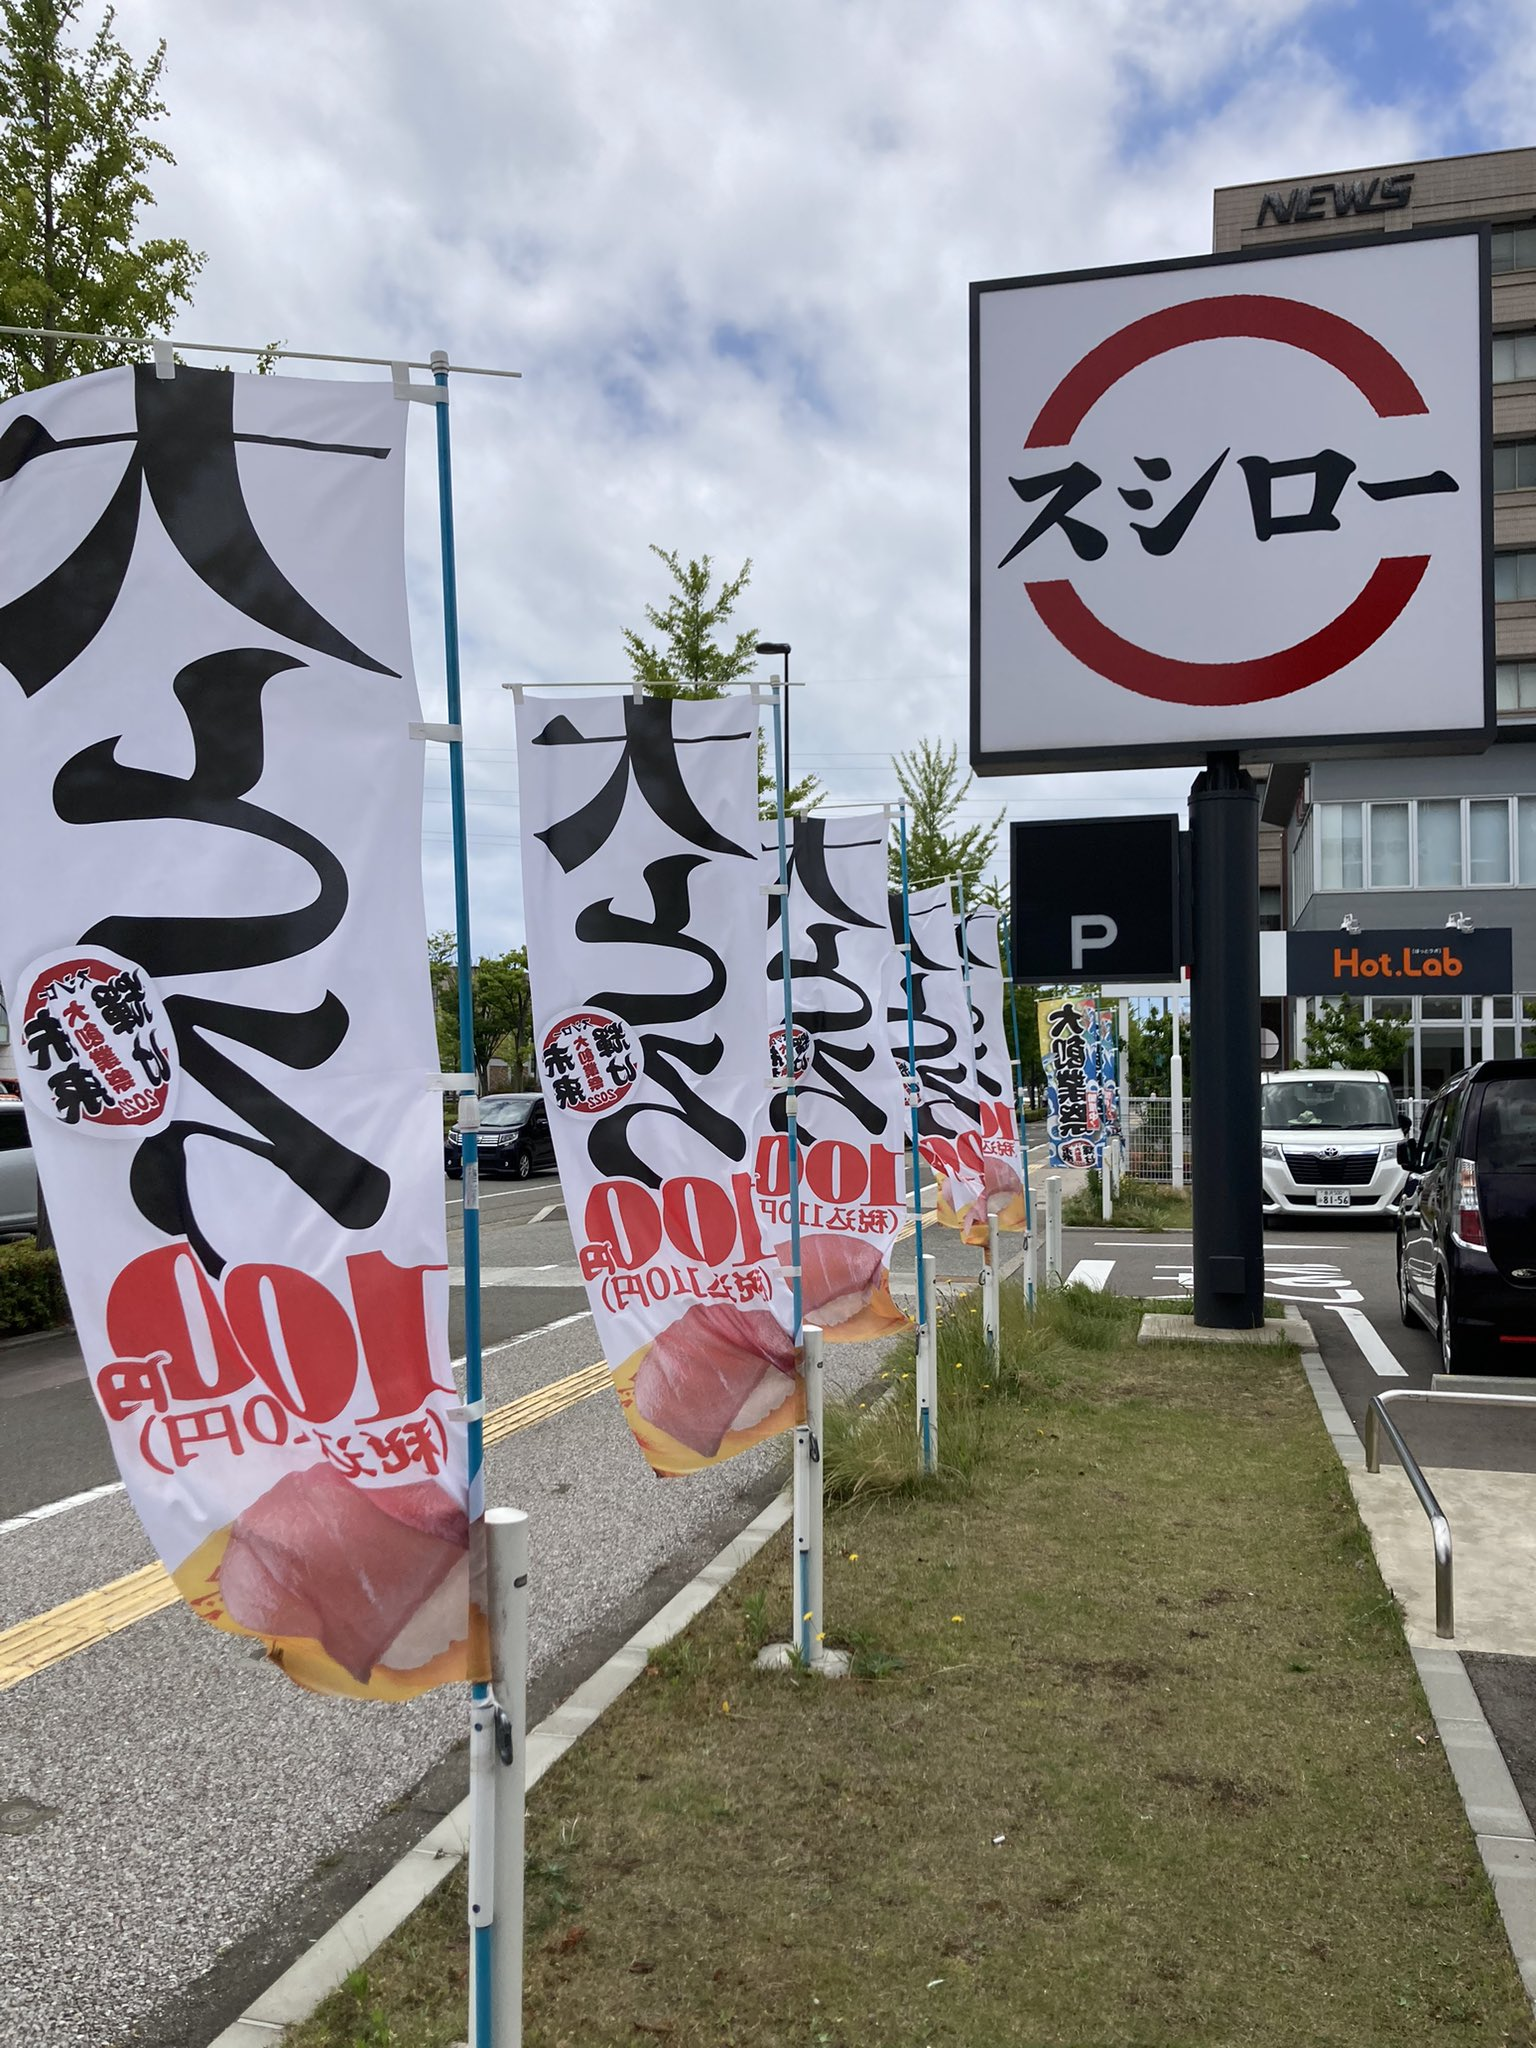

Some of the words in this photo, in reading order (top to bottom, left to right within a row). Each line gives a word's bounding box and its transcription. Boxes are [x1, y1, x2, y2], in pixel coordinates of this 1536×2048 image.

[1256, 173, 1415, 227] NEWS
[998, 447, 1460, 570] スシロー
[1070, 914, 1118, 970] P
[1334, 947, 1463, 978] Hot.Lab
[1323, 1195, 1348, 1205] 81-56
